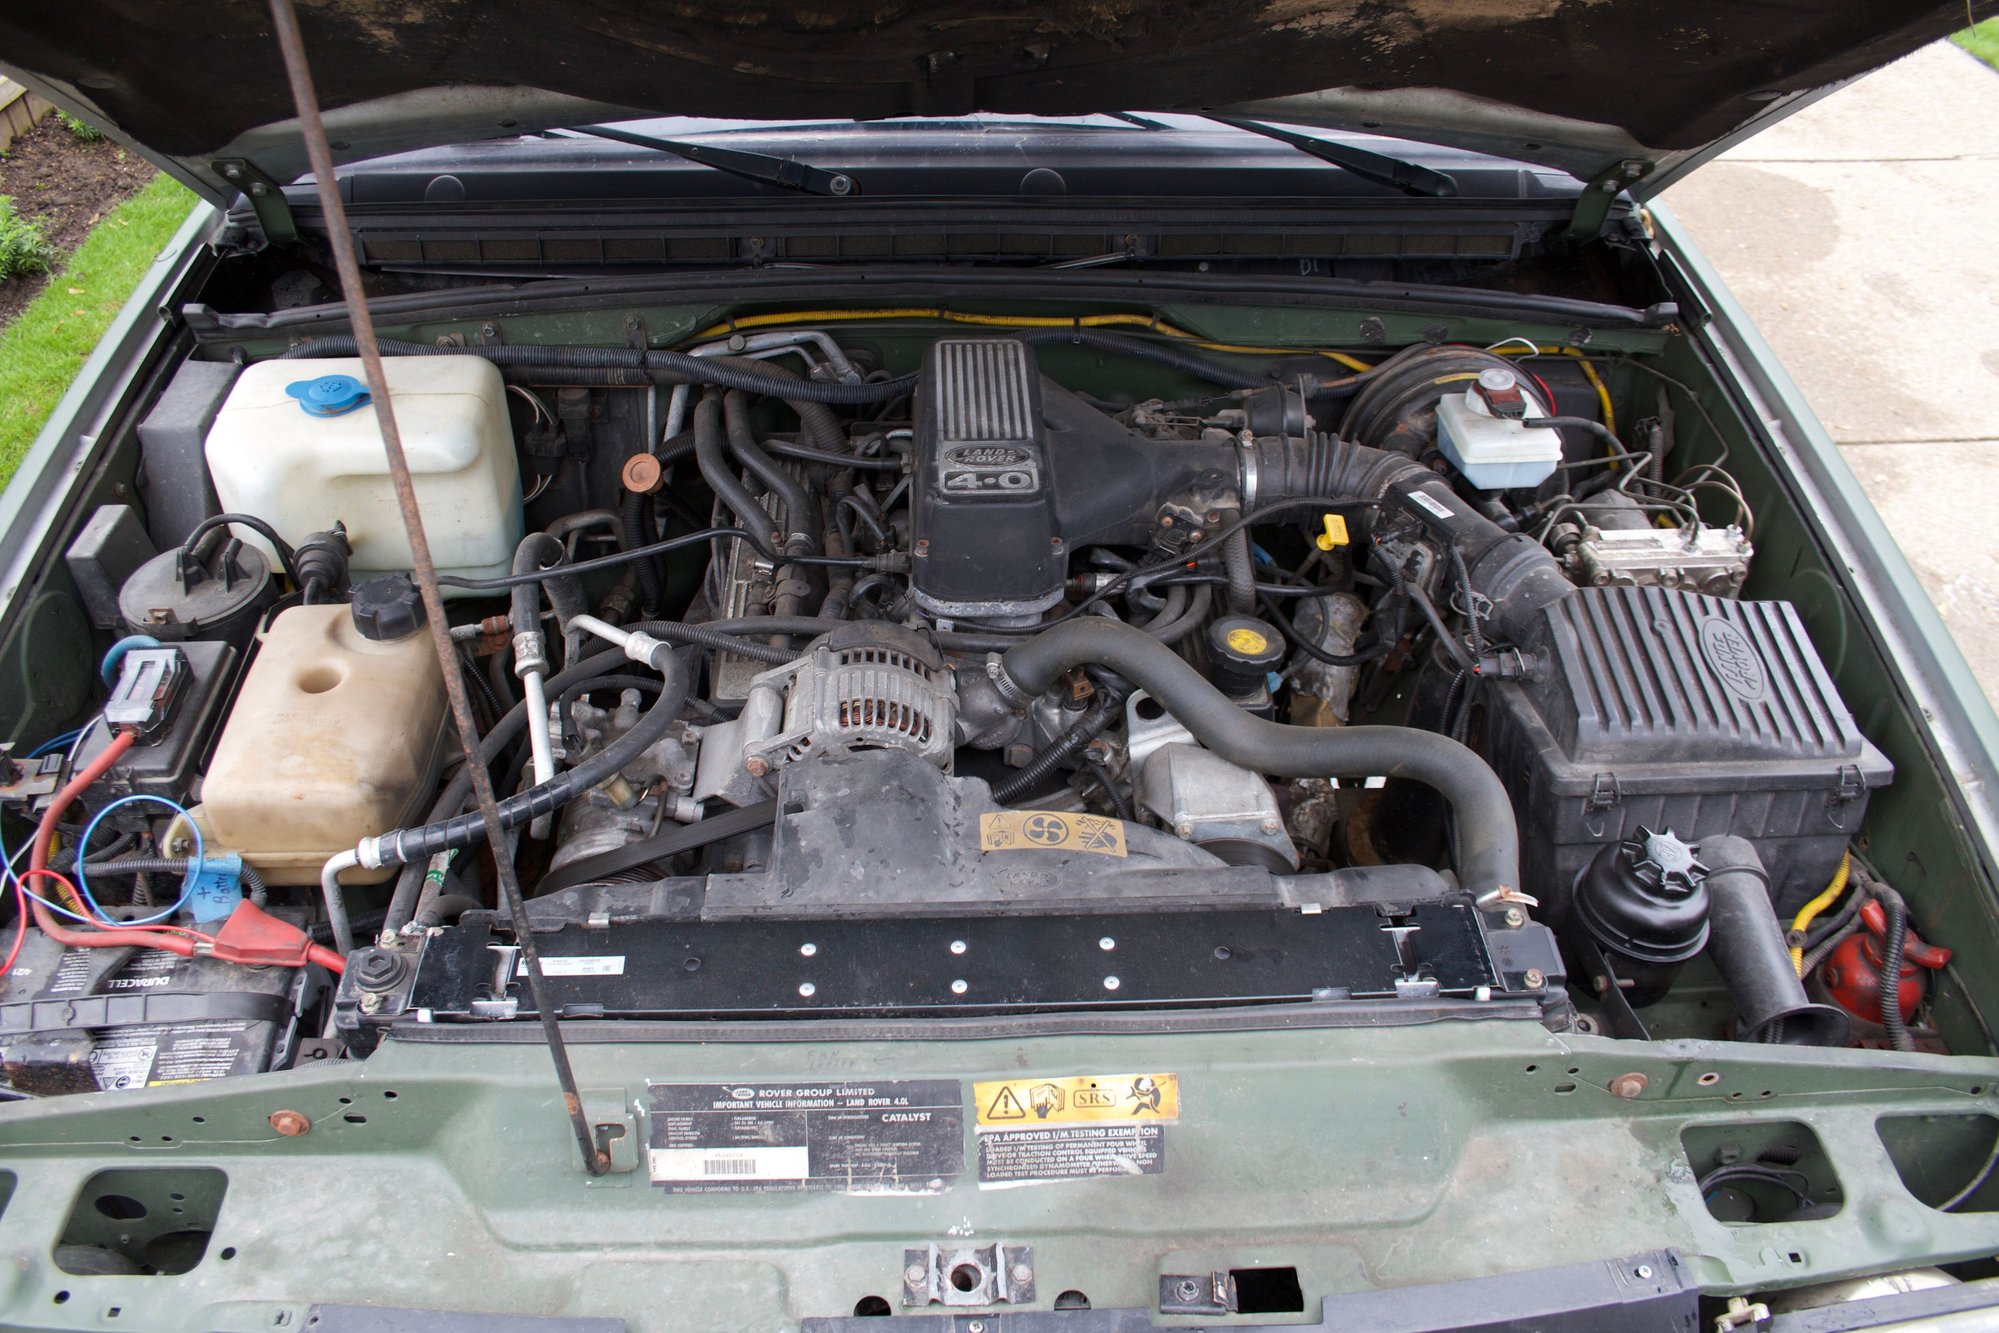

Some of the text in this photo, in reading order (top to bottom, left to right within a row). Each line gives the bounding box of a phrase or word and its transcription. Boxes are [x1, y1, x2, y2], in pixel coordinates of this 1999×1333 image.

[965, 455, 1017, 463] ROVER
[108, 976, 170, 989] DURACELL
[759, 1087, 875, 1097] ROVER GROUP LIMITED
[713, 1097, 909, 1109] IMPORTANT VEHICLE INFORMATION LAND ROVER 4.0L
[1079, 1092, 1111, 1105] SRS
[881, 1112, 932, 1122] CATALYST
[1003, 1131, 1051, 1142] APPROVED
[1052, 1130, 1069, 1140] I/M
[1071, 1128, 1106, 1138] TESTING
[1107, 1127, 1158, 1137] EXEMPION
[1039, 1161, 1091, 1169] DYNAMOMETER
[1029, 1168, 1068, 1176] PROCEDURE
